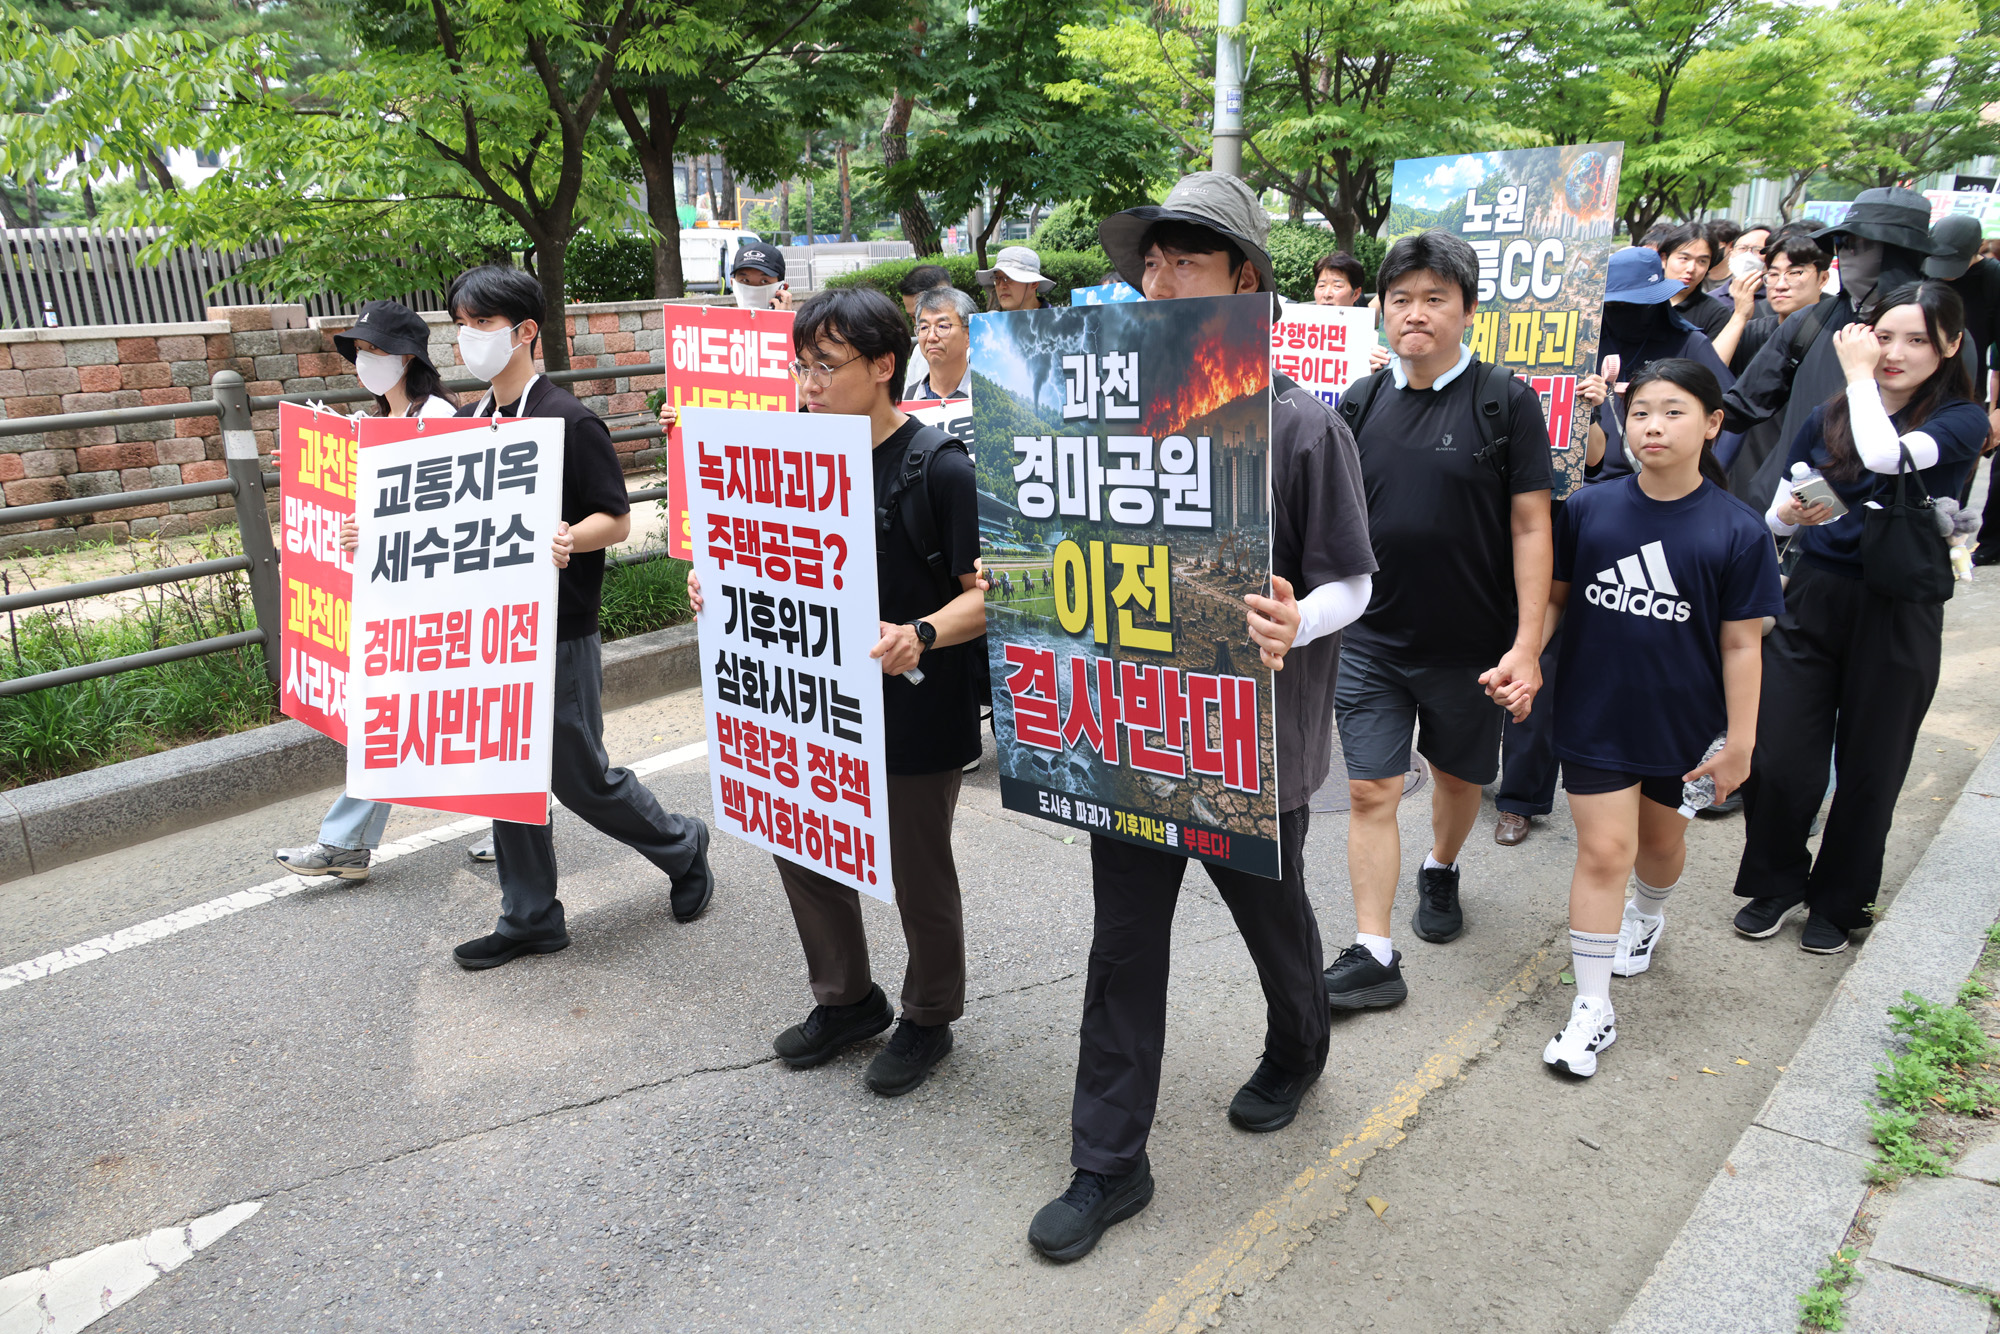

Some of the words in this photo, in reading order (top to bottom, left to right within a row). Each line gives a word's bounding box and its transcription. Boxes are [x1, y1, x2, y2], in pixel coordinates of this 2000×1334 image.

[1462, 185, 1528, 233] 노원
[671, 324, 789, 379] 해도해도
[1272, 322, 1347, 352] 강행하면
[1504, 310, 1579, 366] 파괴
[1062, 351, 1140, 420] 과천
[373, 440, 539, 518] 교통지옥
[698, 441, 851, 517] 녹지파괴가
[1012, 435, 1213, 528] 경마공원
[371, 513, 535, 584] 세수감소
[707, 513, 848, 590] 주택공급?
[721, 584, 841, 666] 기후위기
[1053, 539, 1173, 653] 이전
[1585, 583, 1692, 622] adidas
[364, 608, 472, 677] 경마공원
[481, 601, 540, 665] 이전
[364, 682, 532, 769] 결사반대!
[715, 649, 863, 745] 심화시키는
[1004, 642, 1260, 794] 결사반대
[716, 712, 800, 789] 반환경
[806, 742, 872, 819] 정책
[720, 774, 877, 885] 백지화하라!
[1038, 790, 1072, 820] 도시숲
[1074, 800, 1111, 831] 파괴가
[1114, 810, 1179, 848] 기후재난을
[1183, 826, 1230, 860] 부른다!
